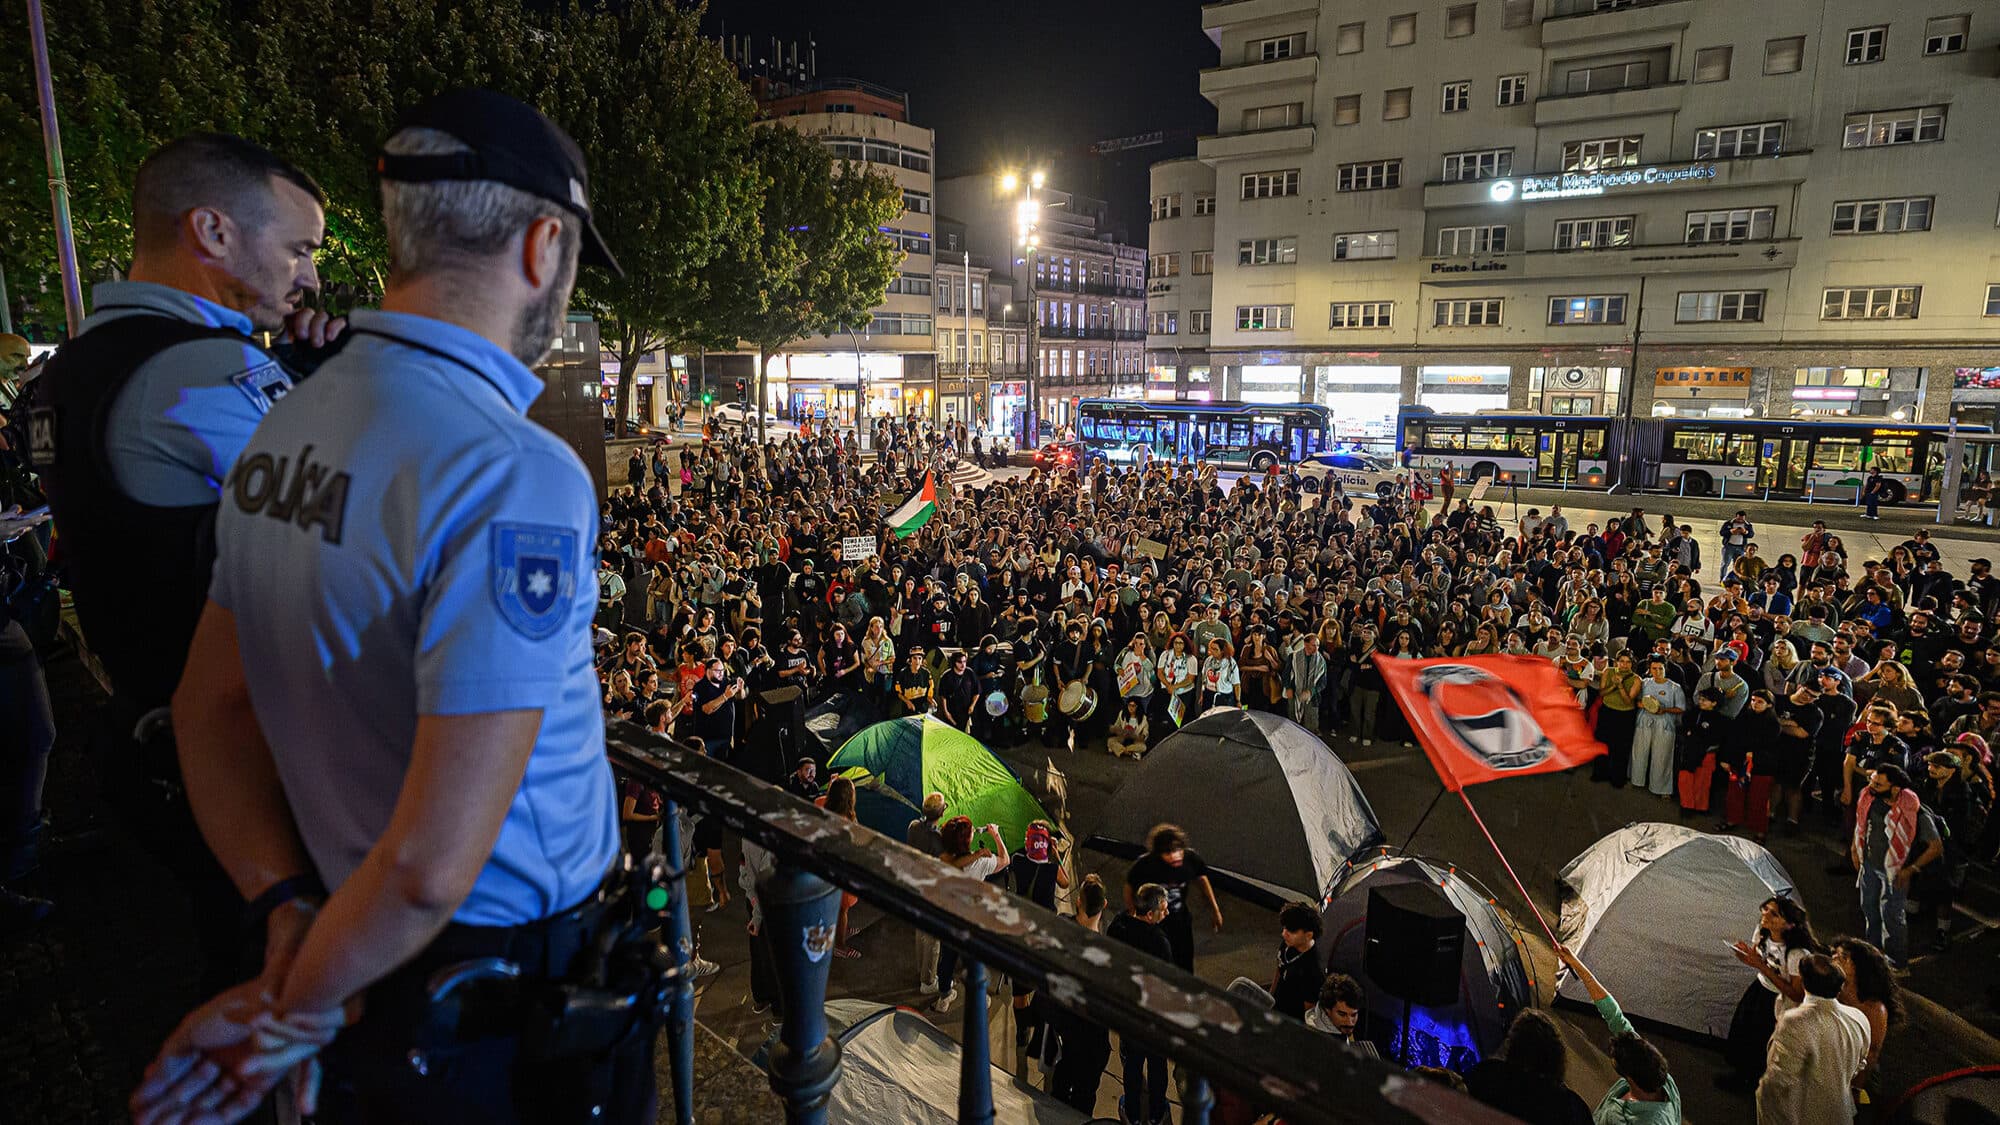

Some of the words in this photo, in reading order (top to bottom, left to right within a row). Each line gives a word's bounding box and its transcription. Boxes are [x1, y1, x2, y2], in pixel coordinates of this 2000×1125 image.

[1562, 170, 1641, 188] Machado
[1472, 261, 1507, 272] Leite
[1663, 371, 1745, 382] UBITEK
